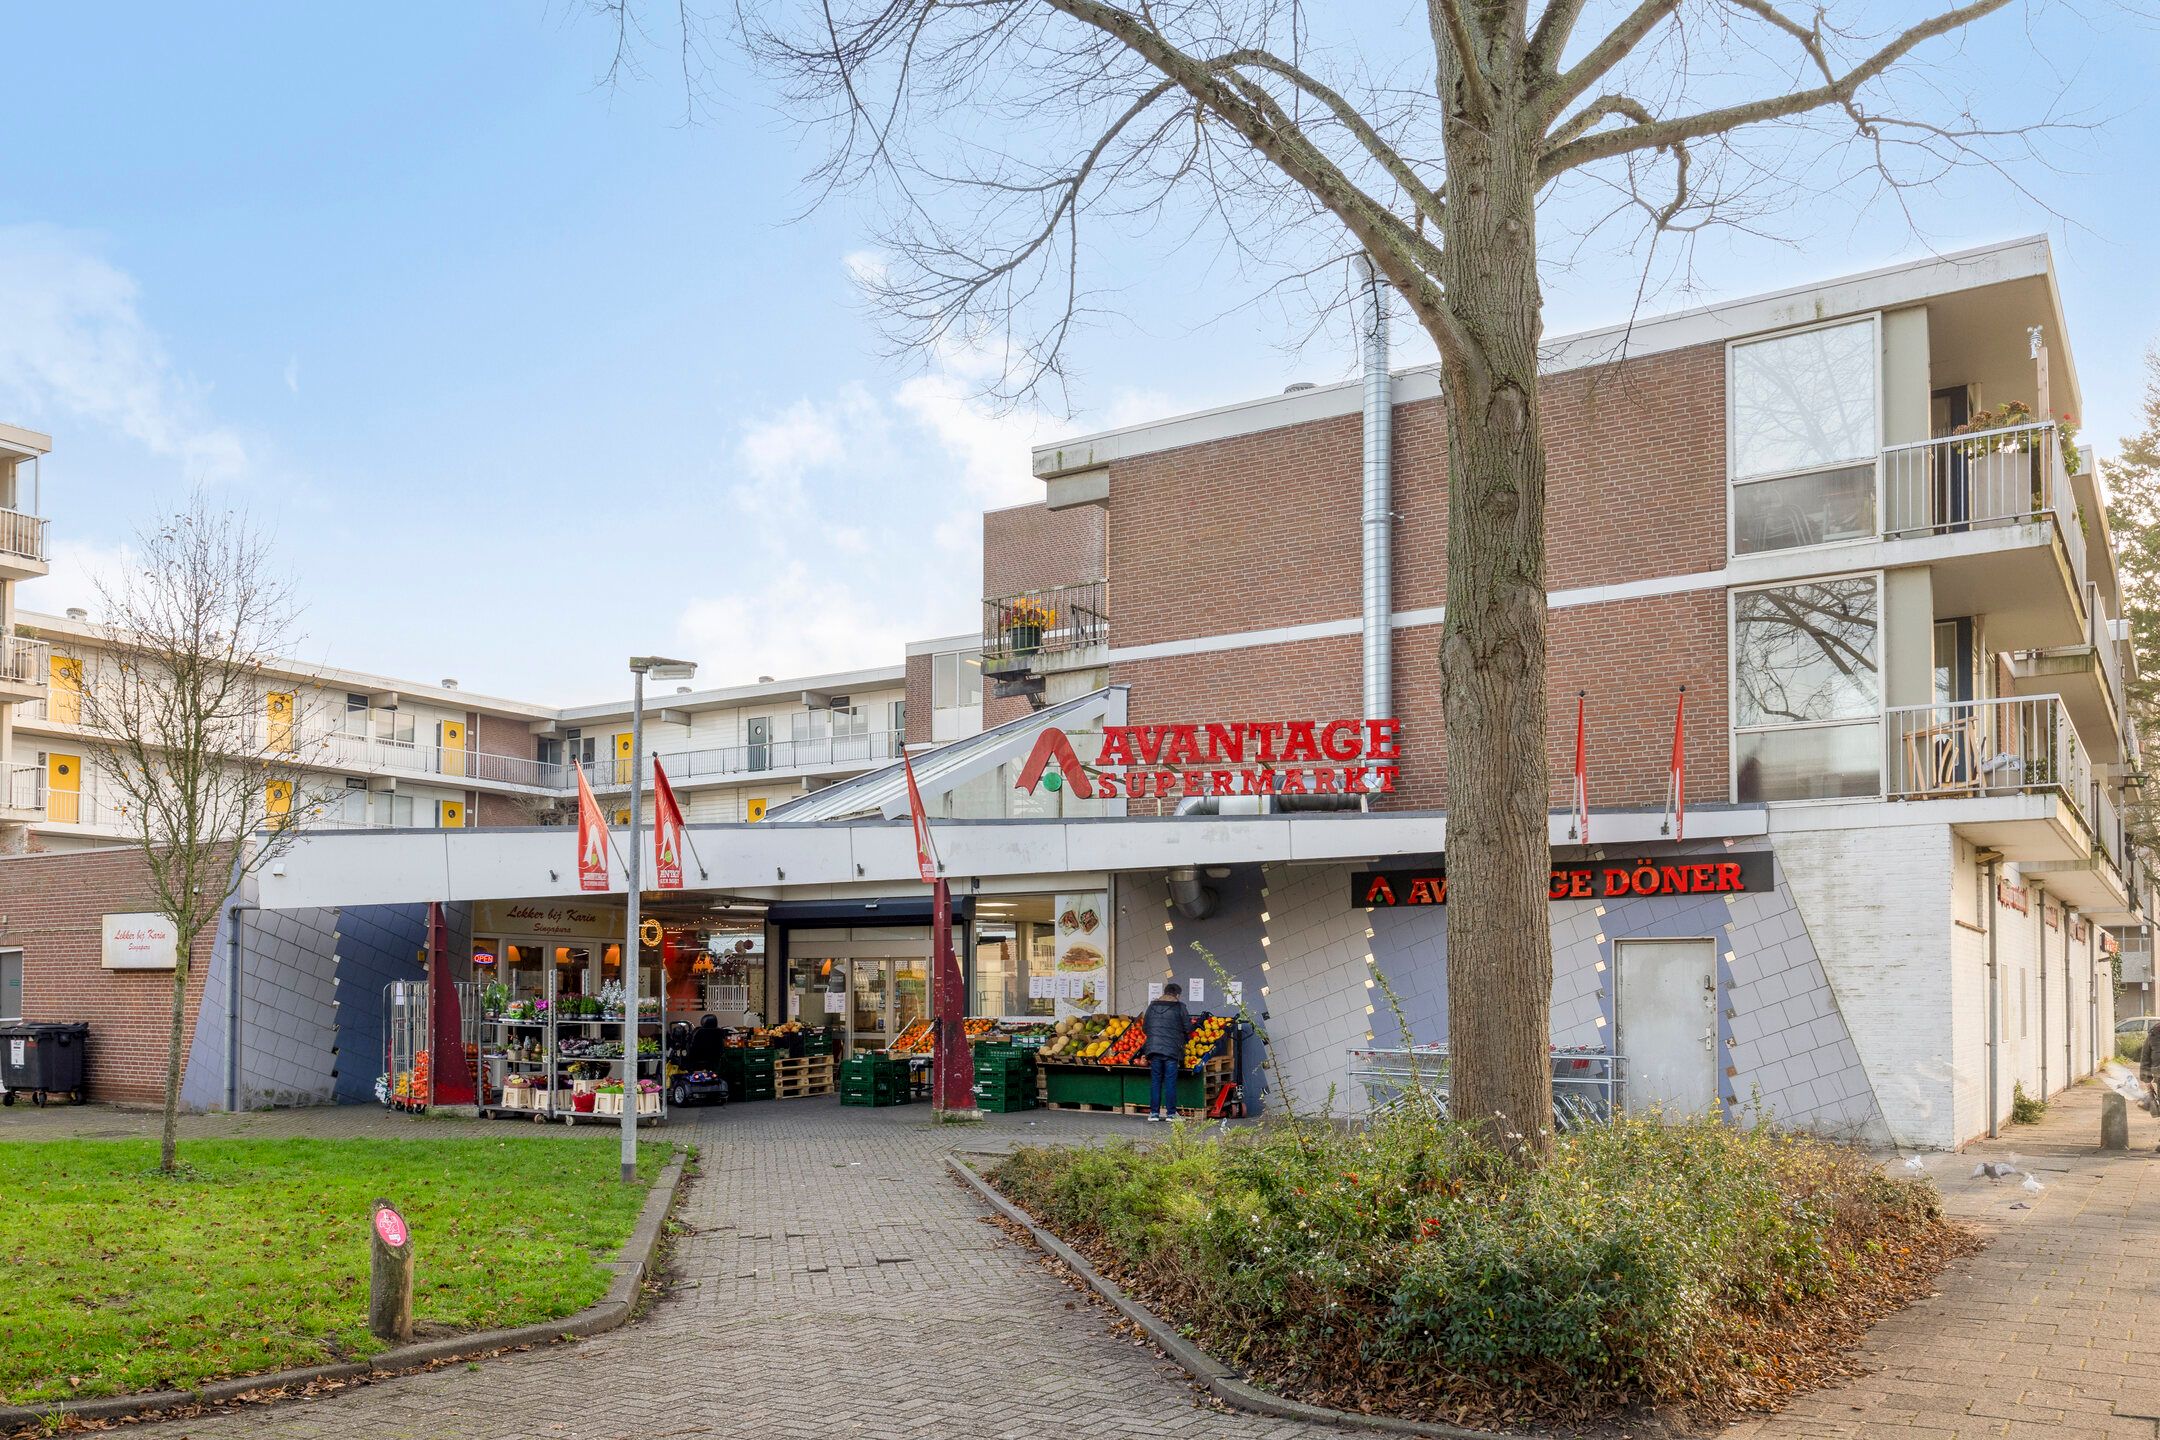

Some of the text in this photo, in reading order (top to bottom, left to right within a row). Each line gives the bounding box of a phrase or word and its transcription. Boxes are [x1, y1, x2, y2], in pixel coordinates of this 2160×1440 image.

[1096, 718, 1402, 766] AVANTAGE
[1098, 766, 1402, 798] SUPERMARKT
[1407, 857, 1744, 904] AVGE DÖNER
[506, 905, 597, 923] Lekker bij Karin
[114, 928, 166, 942] Lekker bij Karin
[533, 923, 572, 934] Singapura
[475, 955, 493, 963] OPEN
